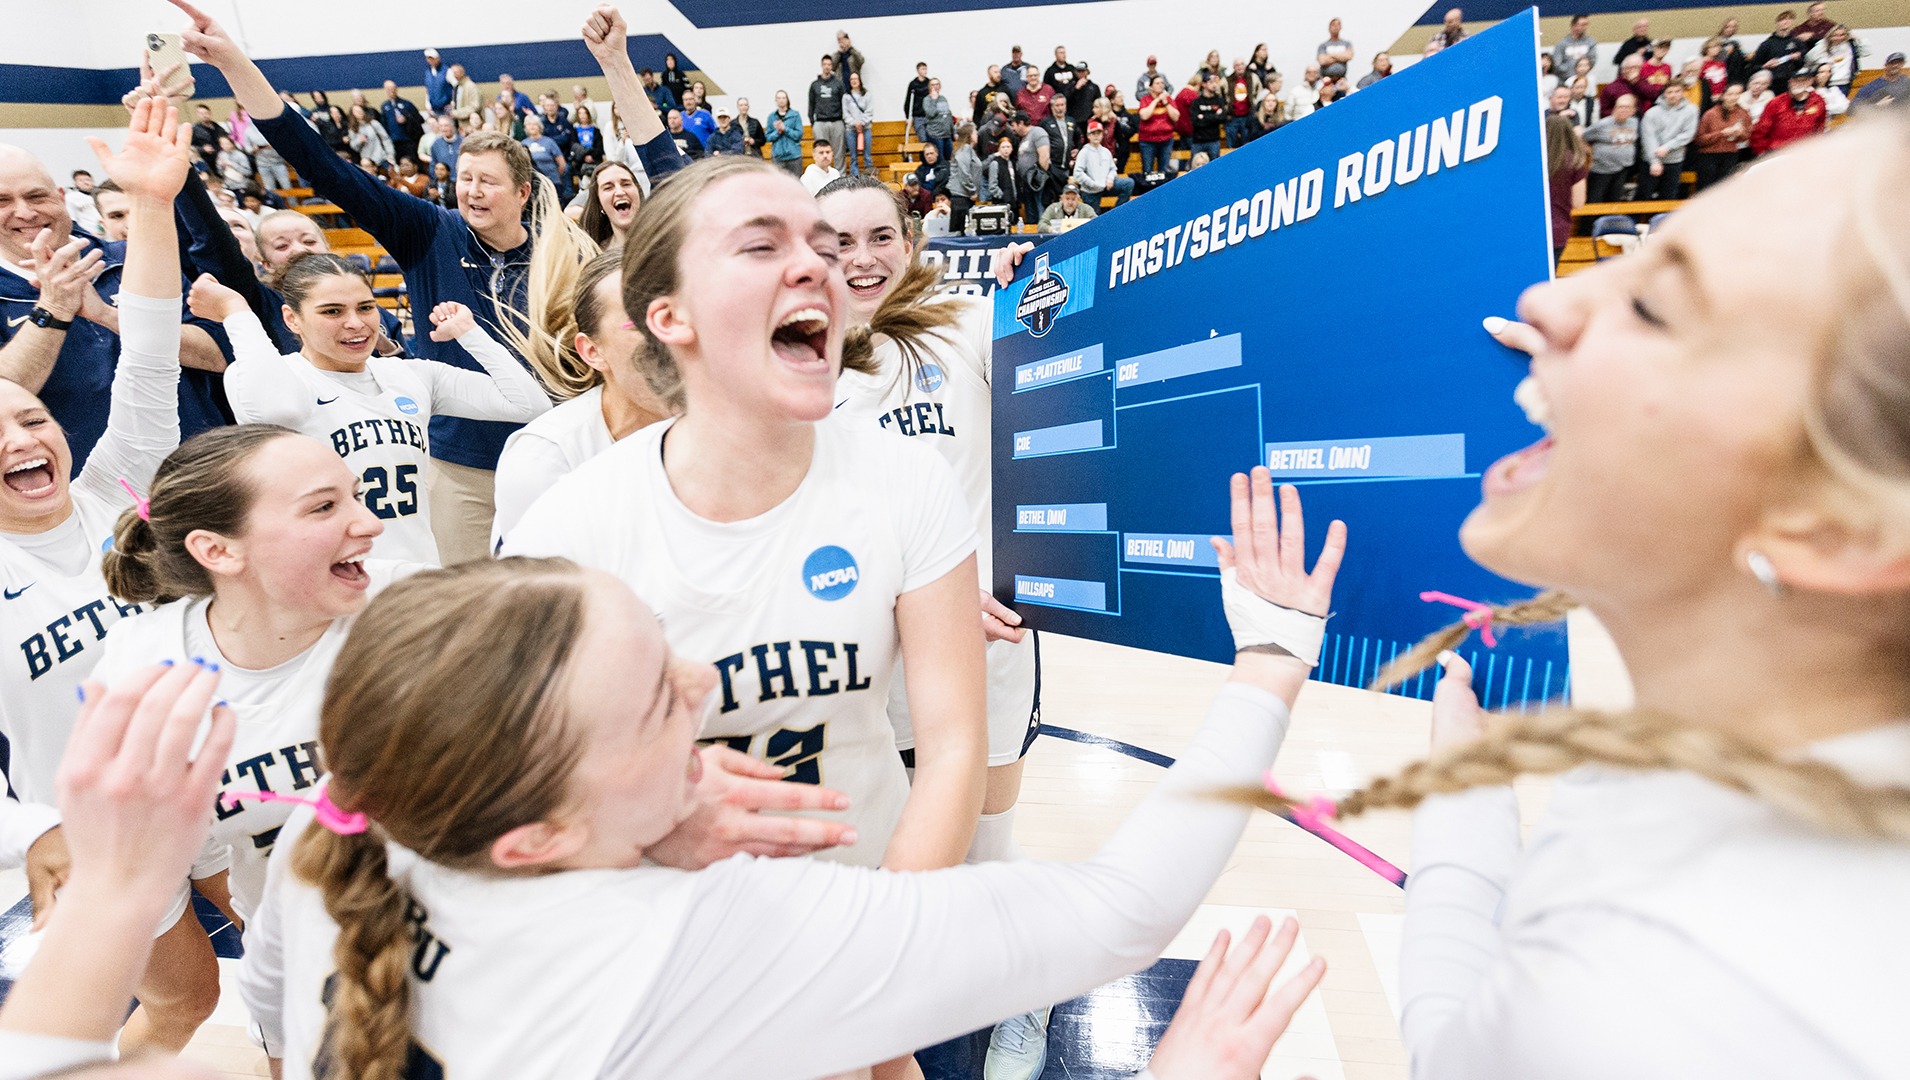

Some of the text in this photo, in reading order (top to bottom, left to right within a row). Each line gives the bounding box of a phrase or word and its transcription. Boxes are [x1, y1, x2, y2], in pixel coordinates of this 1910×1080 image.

[1109, 95, 1503, 289] FIRST/SECOND ROUND
[1017, 289, 1067, 318] CHAMPIONSHIP
[1017, 354, 1083, 385] WIS.-PLATTEVILLE
[1118, 362, 1139, 382] COE
[1016, 436, 1031, 451] COE
[1269, 444, 1371, 470] BETHEL (MN)
[362, 464, 418, 520] 25
[1018, 508, 1067, 526] BETHEL (MN)
[1127, 539, 1195, 560] BETHEL (MN)
[810, 565, 858, 592] NCAA
[1017, 581, 1055, 598] MILLSAPS
